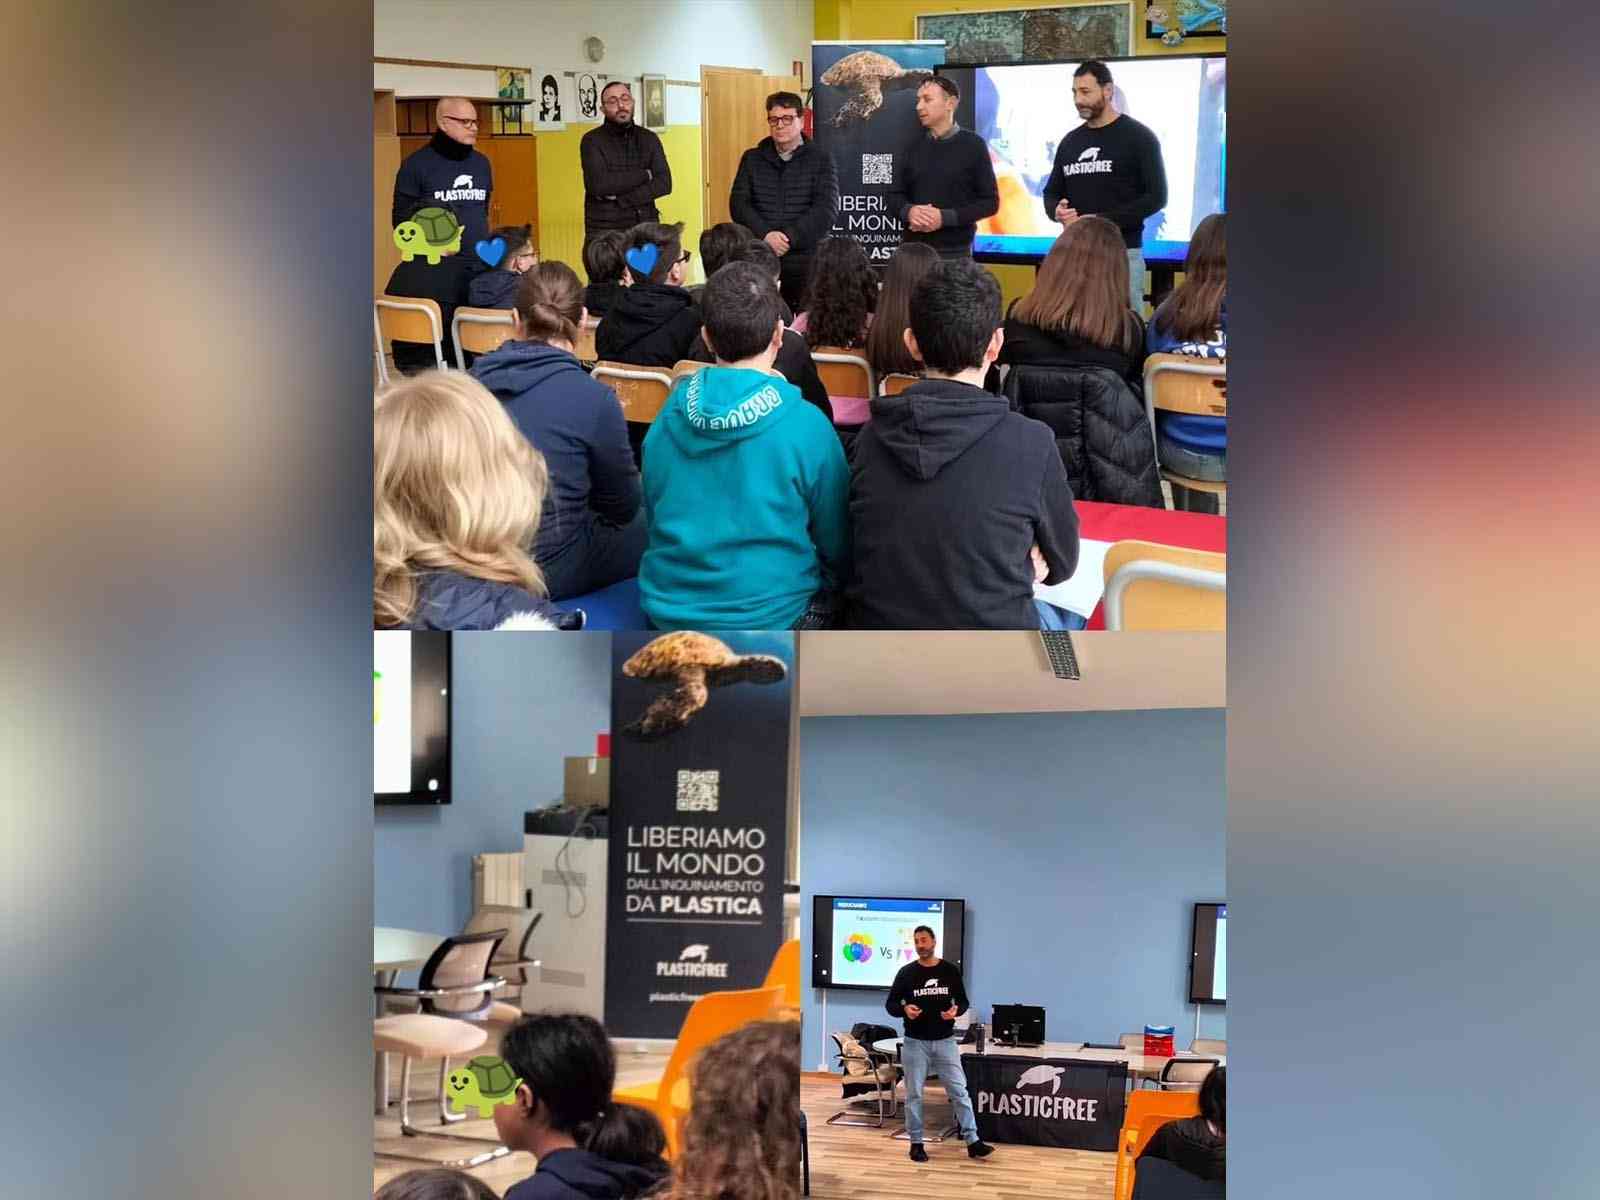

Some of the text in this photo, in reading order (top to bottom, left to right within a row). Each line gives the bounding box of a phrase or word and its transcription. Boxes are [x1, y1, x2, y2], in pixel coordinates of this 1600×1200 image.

[838, 195, 887, 211] IBERI
[848, 215, 904, 231] MON
[627, 826, 765, 849] LIBERIAMO
[626, 852, 765, 876] IL MONDO
[625, 895, 763, 915] DA PLASTICA
[656, 962, 729, 978] PLASTICFREE
[977, 1091, 1098, 1121] PLASTICFREE
